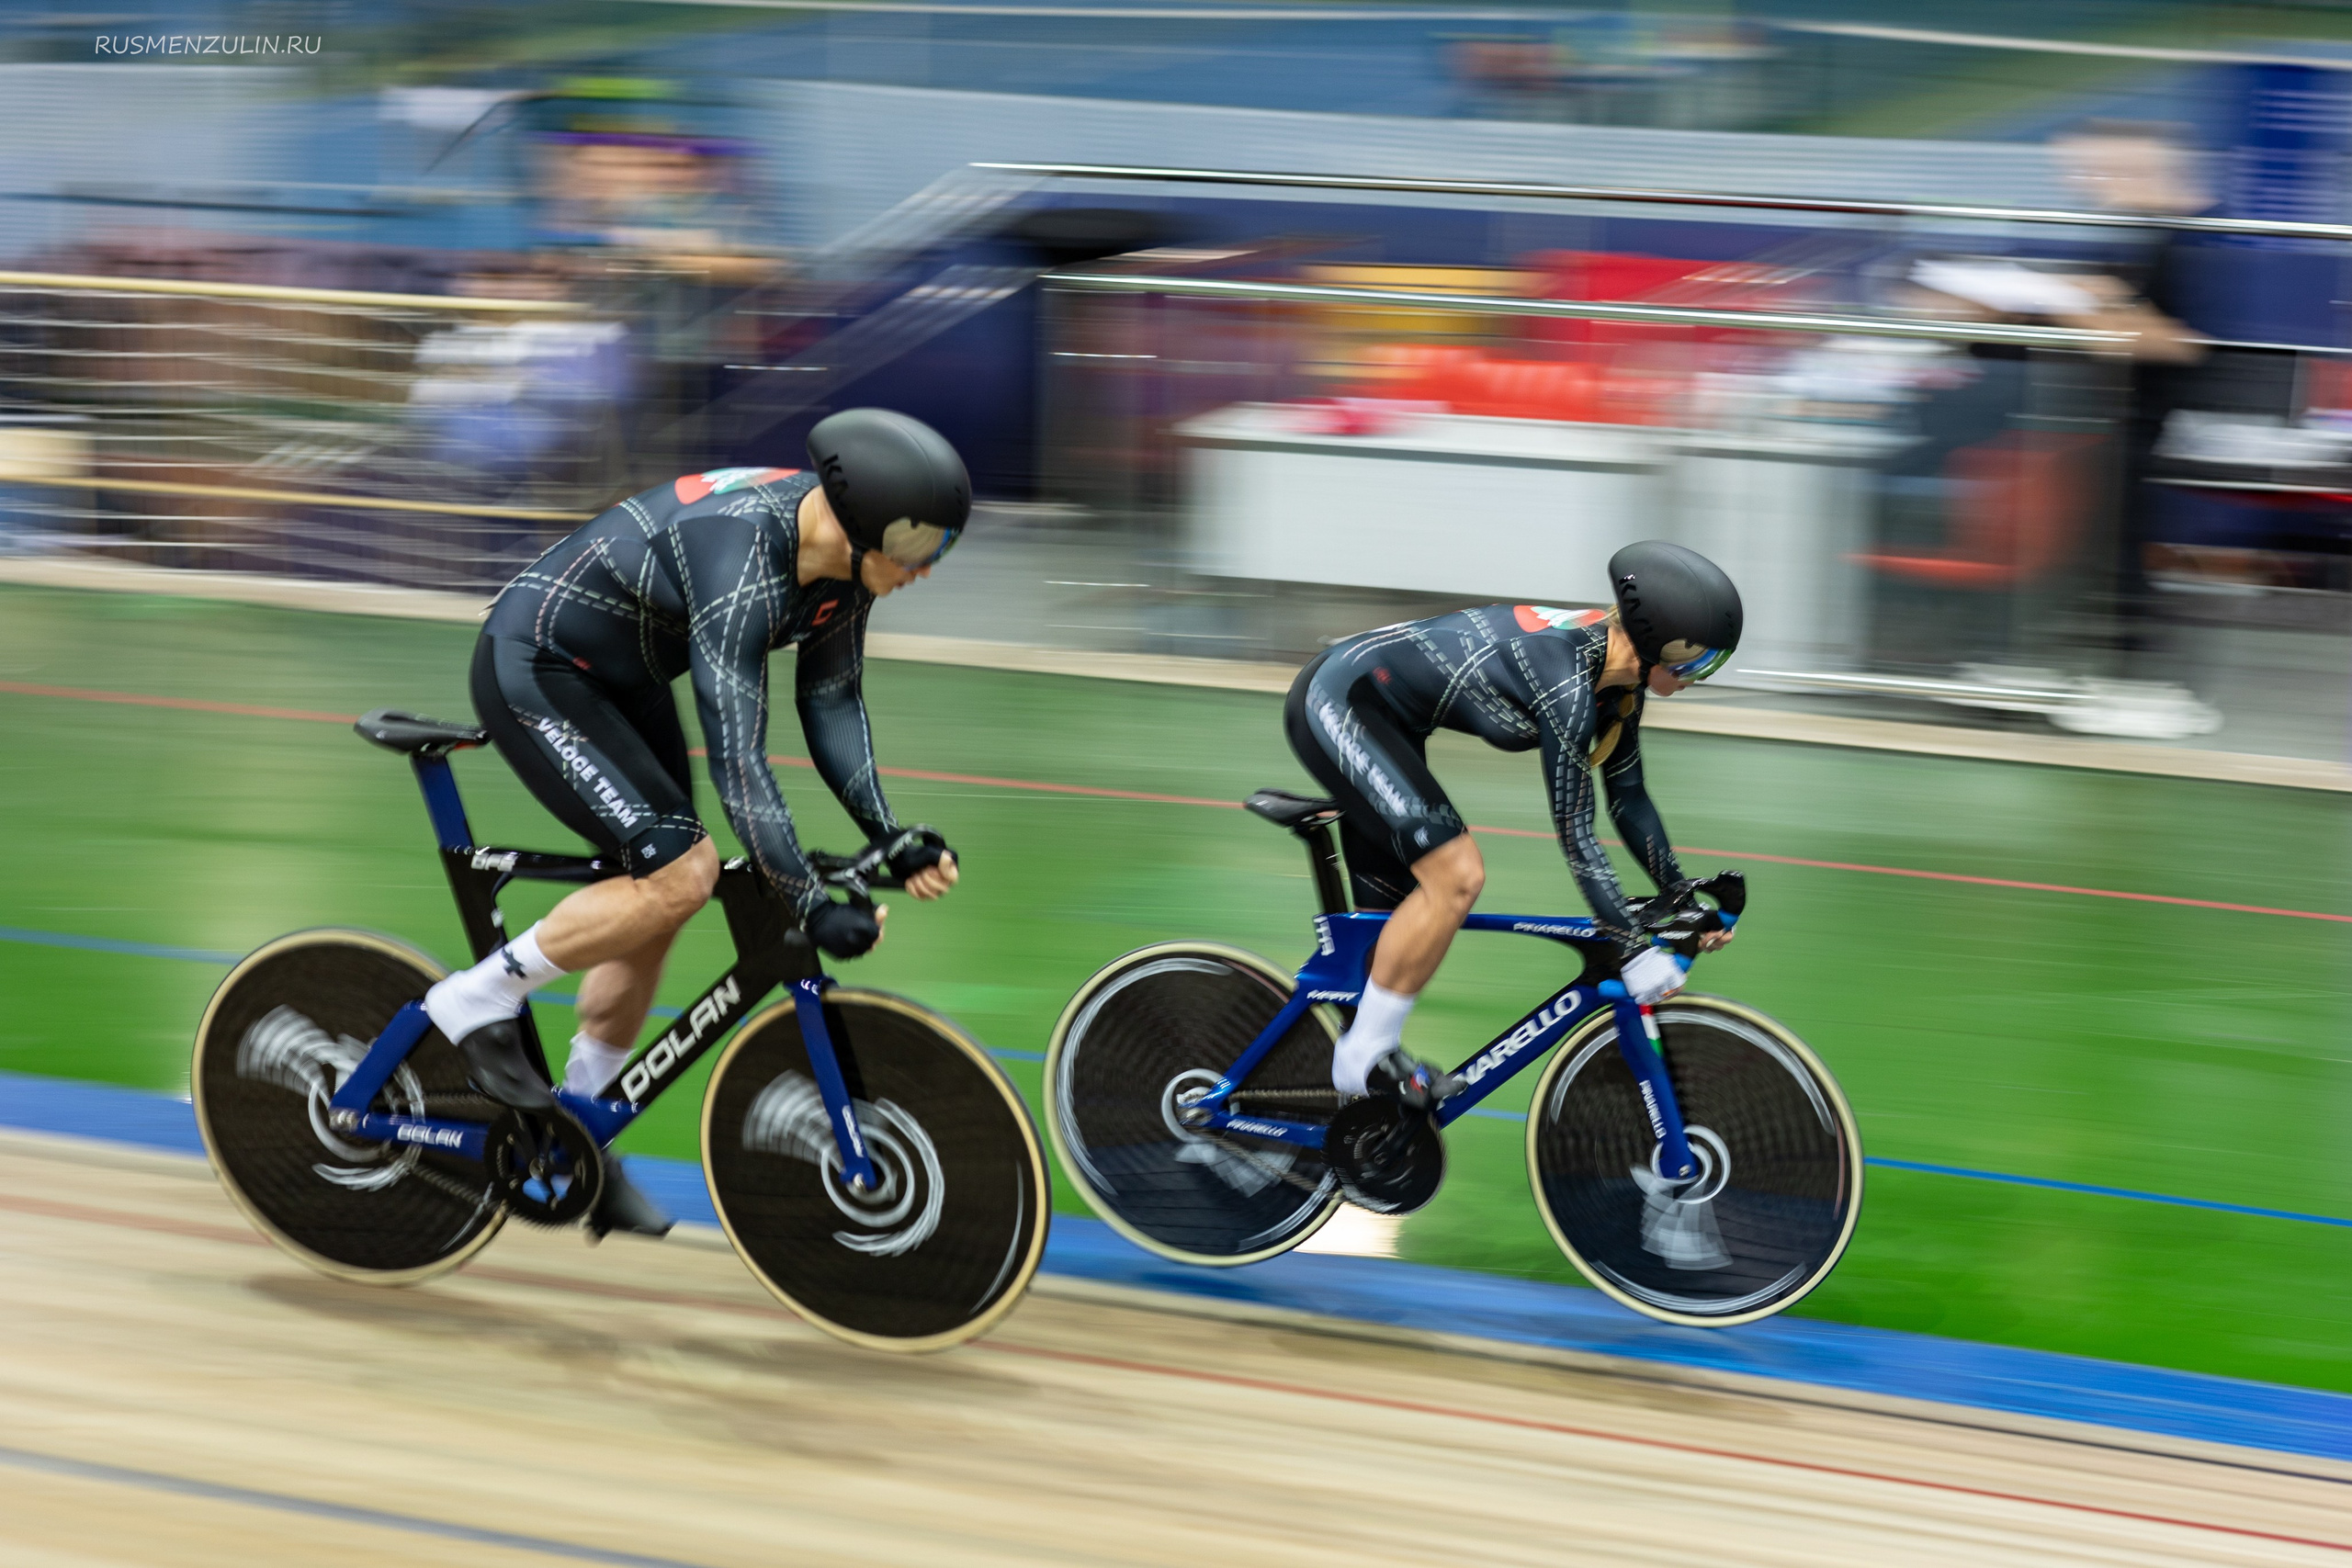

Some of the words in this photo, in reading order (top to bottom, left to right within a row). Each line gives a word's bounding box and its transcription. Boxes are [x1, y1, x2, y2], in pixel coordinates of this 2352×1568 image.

[538, 717, 599, 783] VELOCE
[594, 776, 639, 829] TEAM
[1513, 921, 1596, 938] PINARELLO
[620, 975, 742, 1103] DOLAN
[1436, 989, 1583, 1111] NARELLO
[397, 1123, 464, 1148] DOLAN
